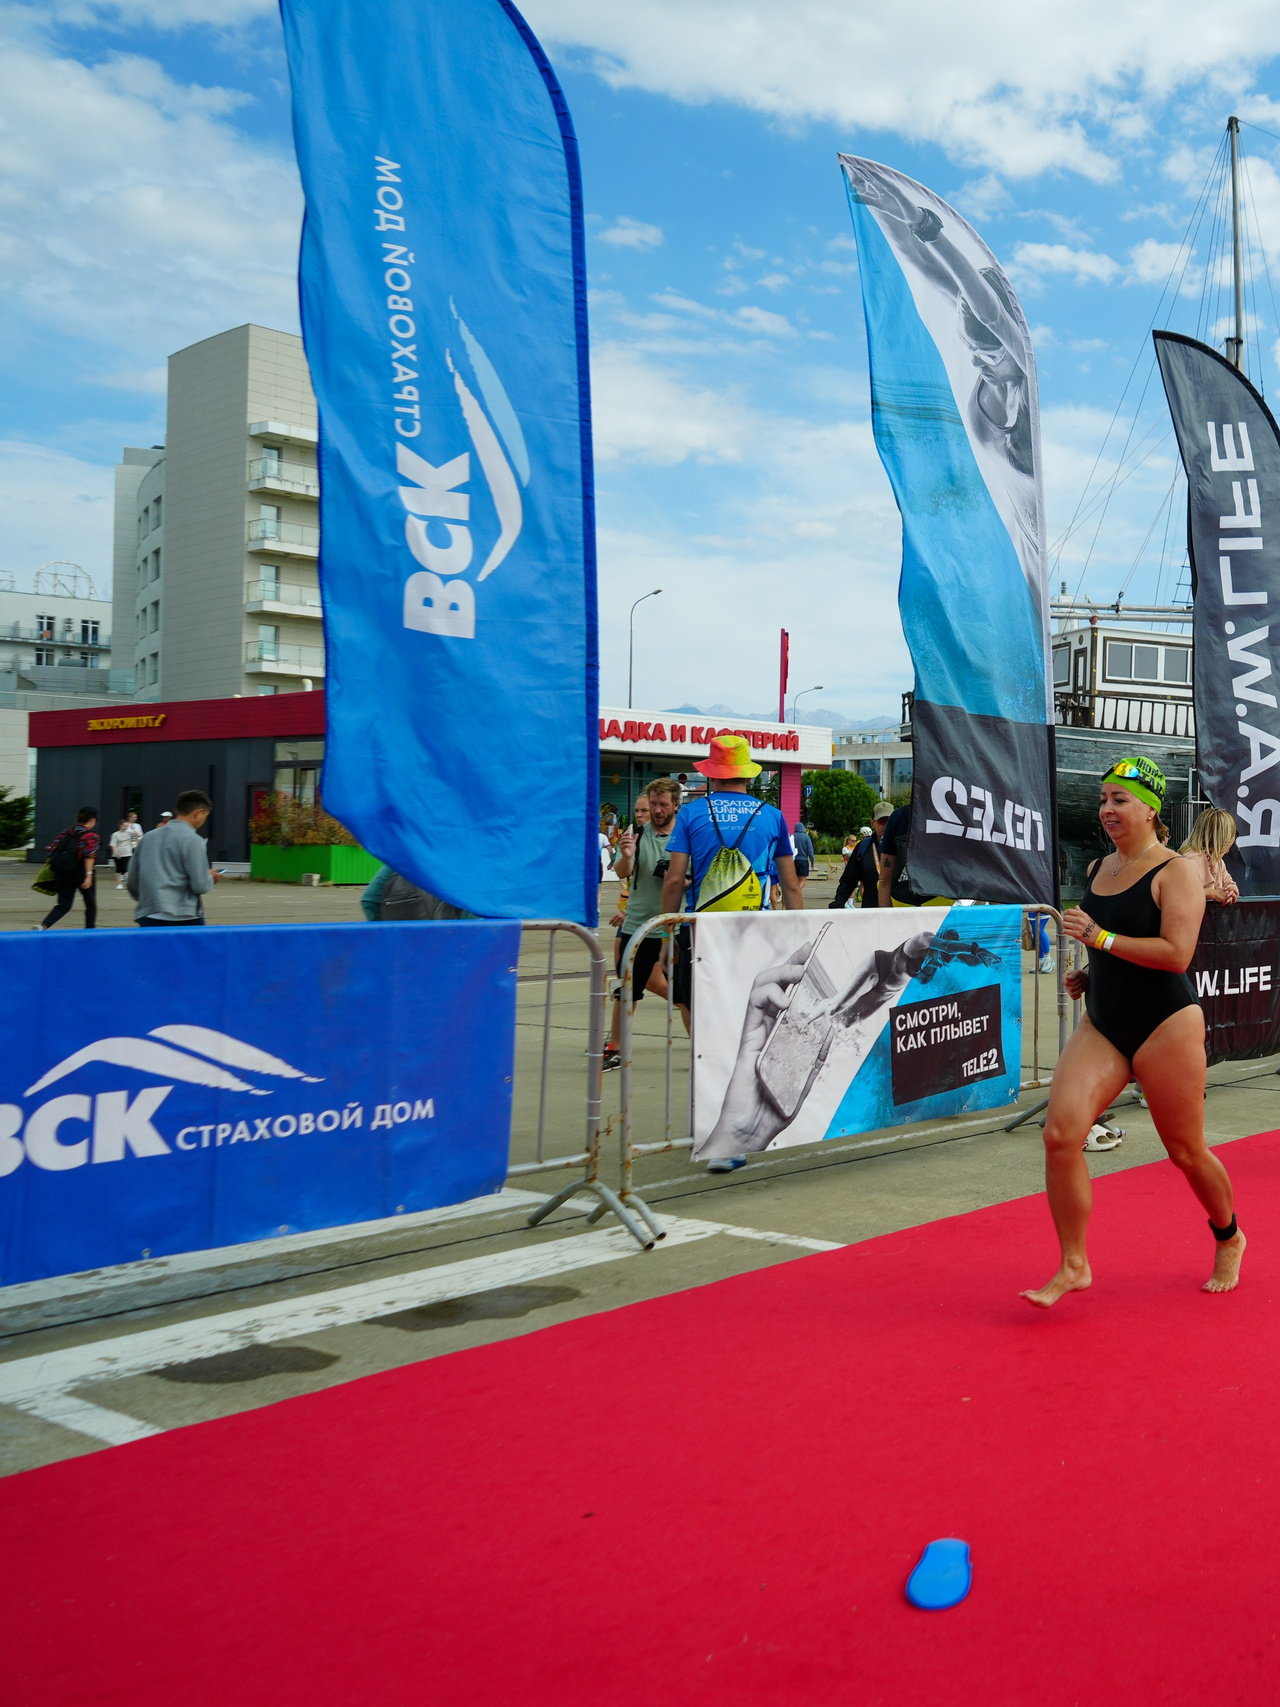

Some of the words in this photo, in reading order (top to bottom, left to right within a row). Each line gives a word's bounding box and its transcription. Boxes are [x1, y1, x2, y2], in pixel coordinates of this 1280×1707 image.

[671, 724, 686, 742] И
[895, 1002, 961, 1032] СМОТРИ,
[896, 1030, 928, 1053] КАК
[930, 1015, 989, 1045] ПЛЫВЕТ
[962, 1048, 999, 1077] TELE2
[176, 1102, 362, 1151] СТРАХОВОЙ
[371, 1098, 435, 1131] ДОМ
